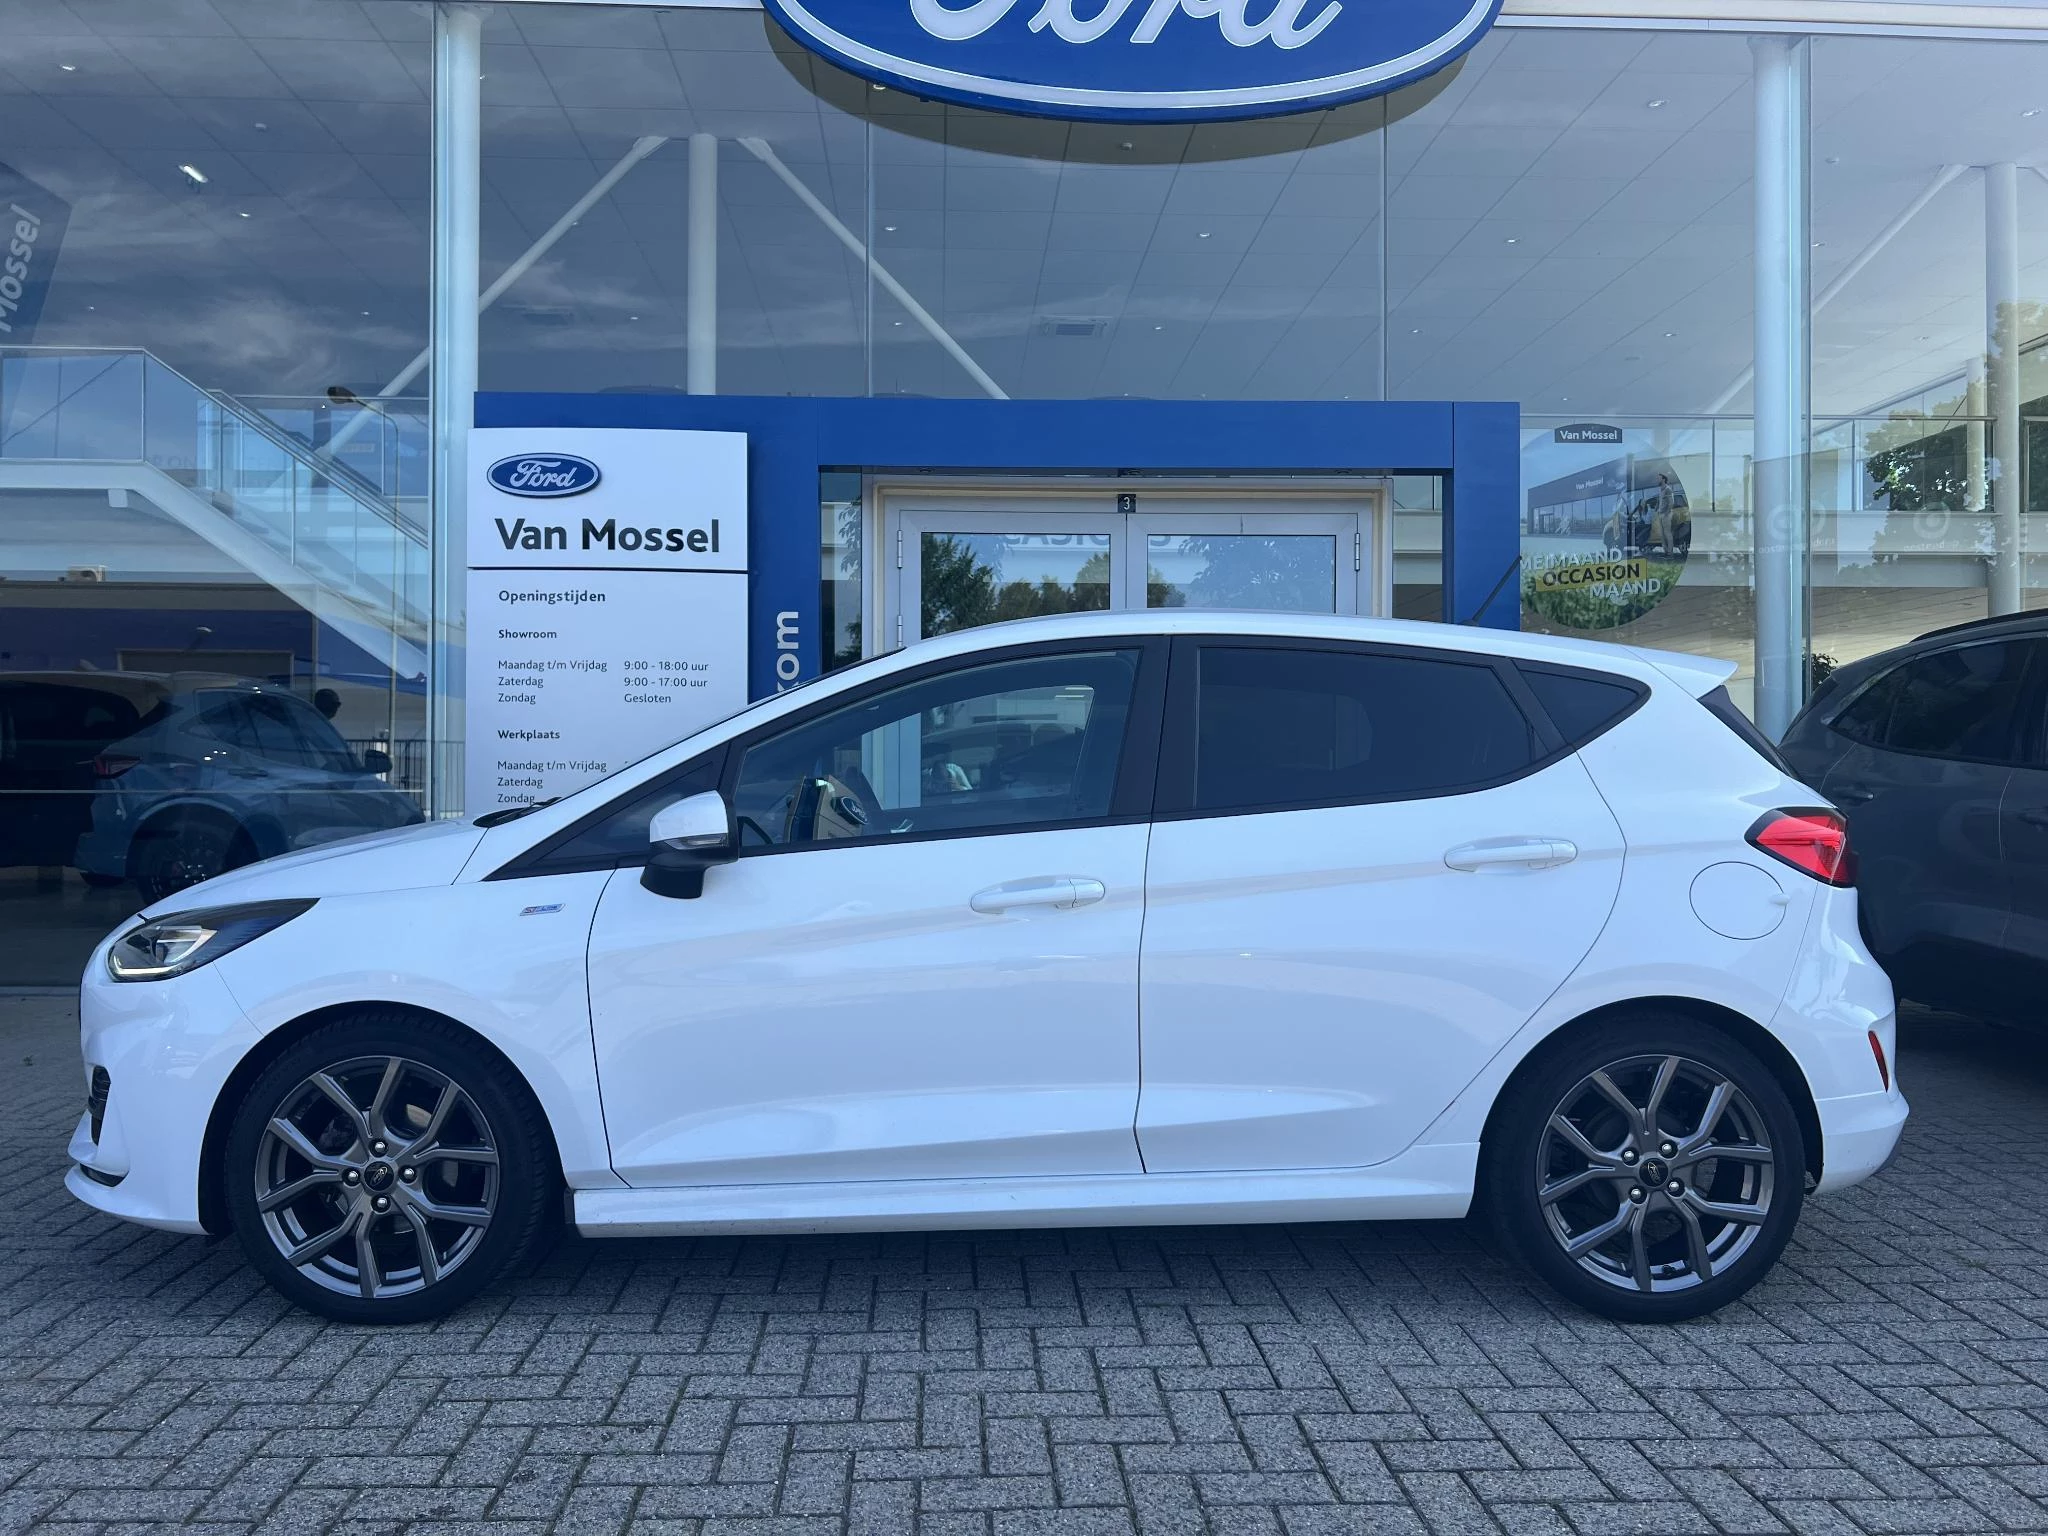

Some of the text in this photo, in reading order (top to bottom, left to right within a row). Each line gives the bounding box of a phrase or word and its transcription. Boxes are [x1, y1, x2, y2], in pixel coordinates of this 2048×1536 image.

[1560, 430, 1617, 440] Van Mossel
[509, 460, 578, 488] Ford
[1123, 496, 1130, 510] 3
[495, 517, 719, 553] Van Mossel
[1542, 563, 1640, 587] OCCASION
[1590, 578, 1661, 598] MAAND
[498, 590, 606, 605] Openingstijden
[498, 629, 557, 639] Showroom
[498, 660, 545, 672] Maandag
[547, 661, 567, 670] t/m
[570, 660, 608, 672] Vrijdag
[624, 661, 649, 671] 9:00
[658, 661, 689, 671] 18:00
[691, 663, 709, 671] uur
[498, 677, 544, 688] Zaterdag
[624, 677, 649, 687] 9:00
[658, 677, 687, 687] 17:00
[690, 679, 708, 688] uur
[498, 693, 672, 705] Zondag Gesloten
[497, 730, 561, 741] Werkplaats
[497, 761, 607, 773] Maandag t/m Vrijdag
[497, 777, 543, 788] Zaterdag
[497, 794, 536, 804] Zondag
